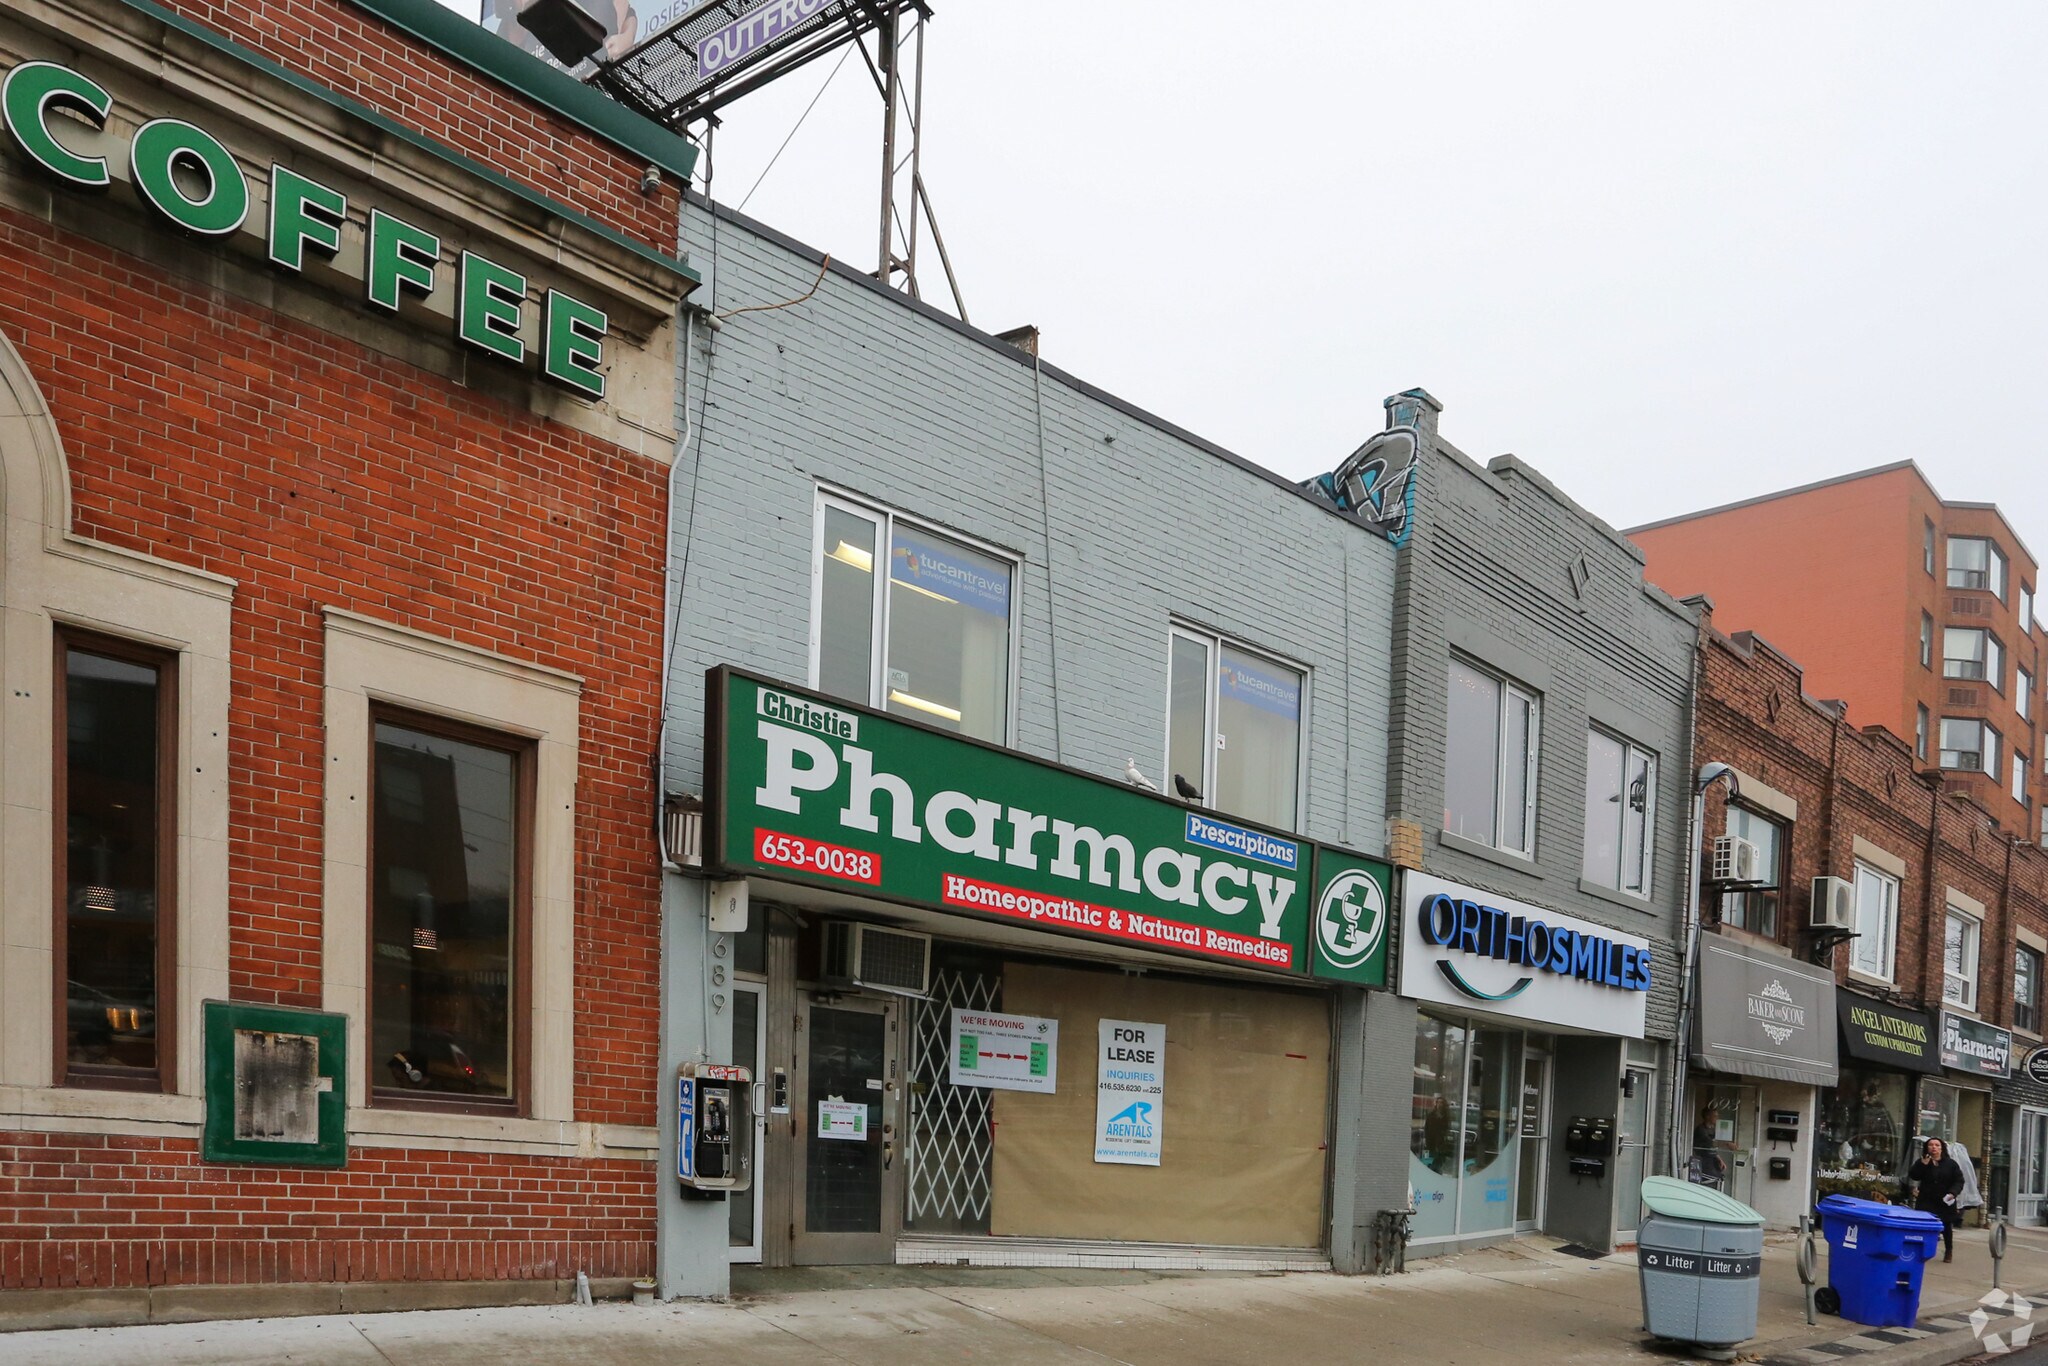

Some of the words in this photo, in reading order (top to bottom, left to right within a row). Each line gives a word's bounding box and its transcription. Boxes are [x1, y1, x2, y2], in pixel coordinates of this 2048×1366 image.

[643, 0, 702, 37] JOSIES
[703, 0, 828, 70] OUTFR
[1, 60, 608, 398] COFFEE
[920, 553, 1006, 596] tucantravel
[763, 692, 852, 738] Christie
[756, 720, 1296, 940] Pharmacy
[1190, 816, 1294, 864] Prescriptions
[761, 835, 873, 880] 653-0038
[946, 876, 1102, 928] Homeopathic
[1107, 909, 1122, 931] &
[1128, 913, 1201, 946] Natural
[1206, 929, 1288, 964] Remedies
[1420, 893, 1652, 991] ORTHOSMILES
[712, 936, 728, 1015] 689
[960, 1015, 987, 1026] WE'RE
[989, 1019, 1025, 1030] MOVING
[1748, 997, 1775, 1019] BAKER
[1782, 1006, 1805, 1026] SCONE
[1851, 1006, 1882, 1032] ANGEL
[1882, 1013, 1927, 1043] INTERIORS
[1114, 1028, 1145, 1043] FOR
[1864, 1031, 1889, 1048] CUSTOM
[1889, 1037, 1923, 1056] UPHOLSTERY
[1107, 1047, 1155, 1064] LEASE
[1106, 1069, 1155, 1082] INQUIRIES
[1106, 1123, 1153, 1139] ARENTALS
[1097, 1148, 1159, 1159] www.arentals.ca
[1665, 1255, 1694, 1270] Litter
[1708, 1260, 1731, 1273] Litter
